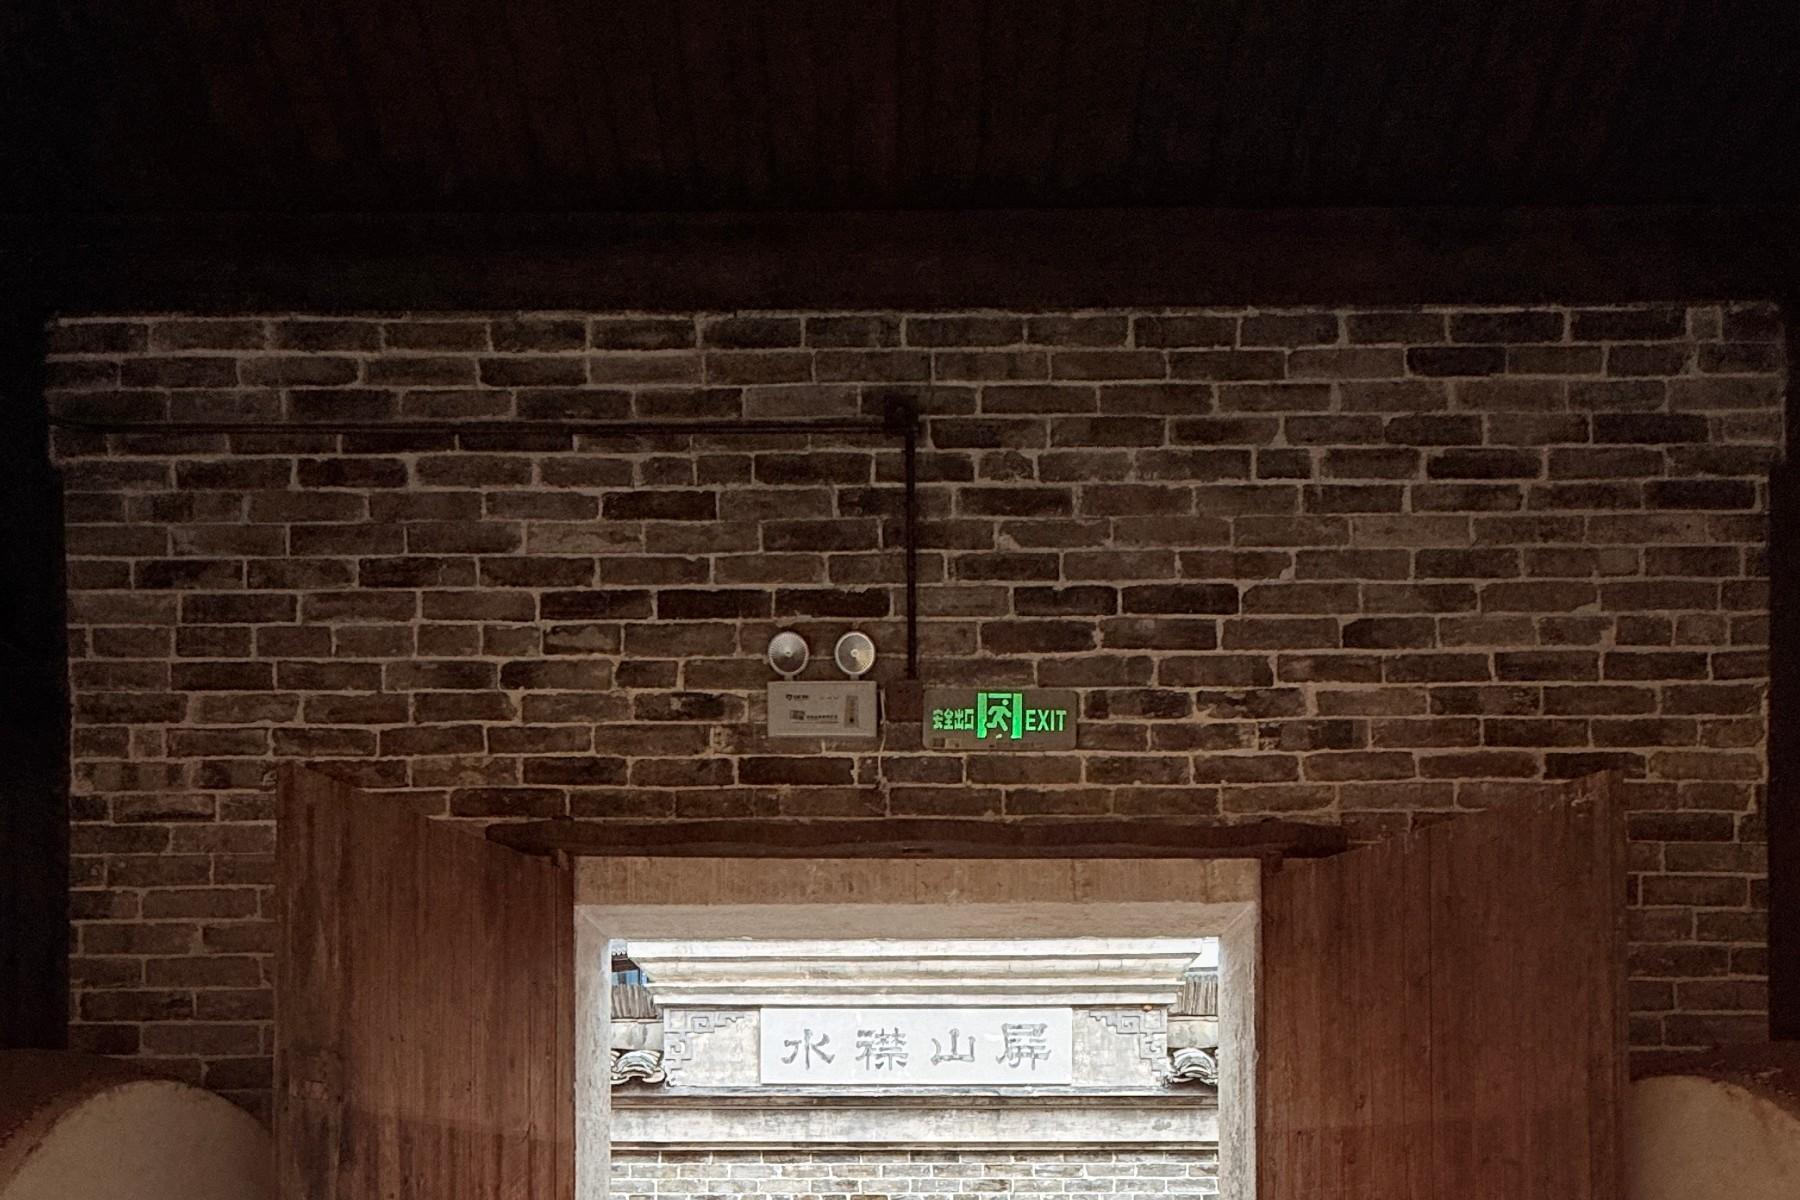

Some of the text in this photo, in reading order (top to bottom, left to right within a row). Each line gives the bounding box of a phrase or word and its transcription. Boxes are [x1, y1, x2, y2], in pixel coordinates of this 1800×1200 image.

[932, 708, 975, 730] 安全出口
[1025, 709, 1067, 731] EXIT
